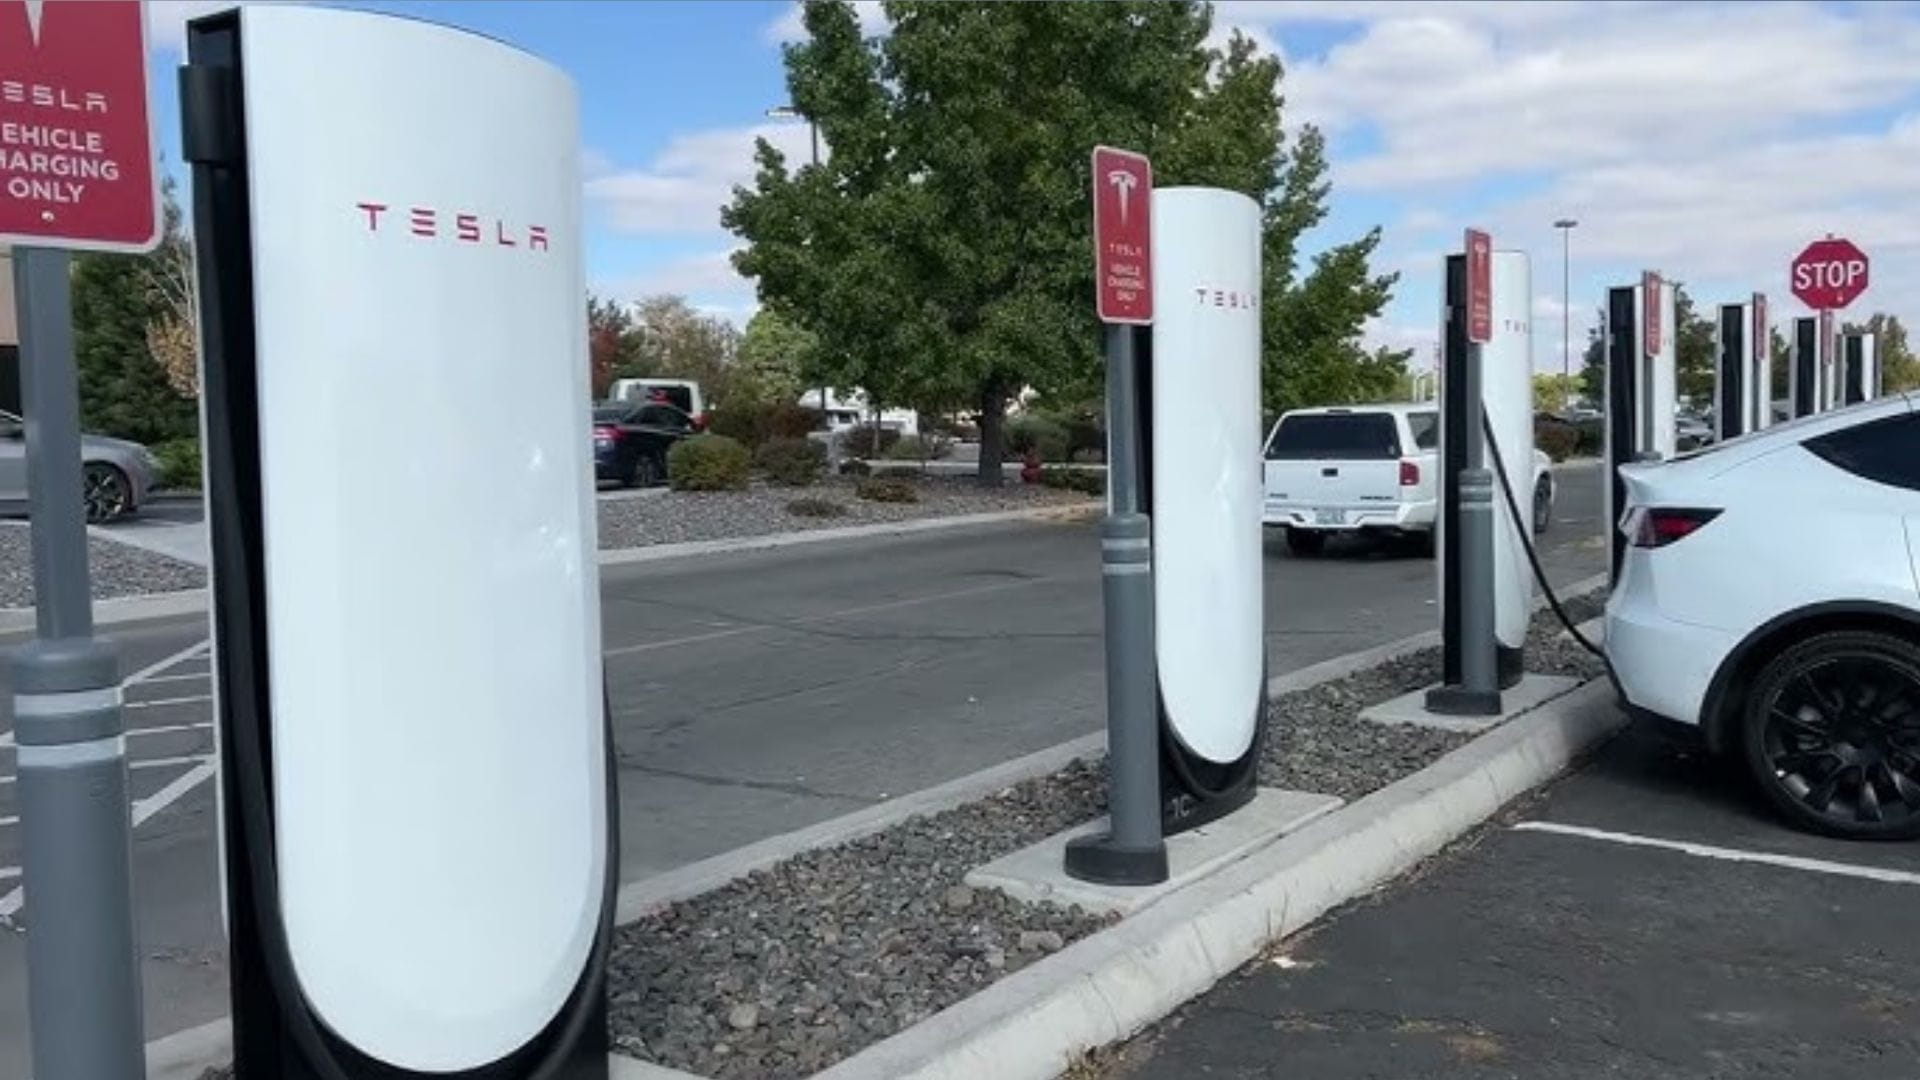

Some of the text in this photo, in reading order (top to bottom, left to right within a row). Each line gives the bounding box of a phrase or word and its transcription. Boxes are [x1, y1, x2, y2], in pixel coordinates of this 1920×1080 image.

[1, 80, 108, 113] ESLA
[1, 122, 104, 153] EHICLE
[0, 148, 119, 181] ARGING
[8, 176, 85, 203] ONLY
[356, 203, 548, 252] TESLA
[1794, 260, 1866, 290] STOP
